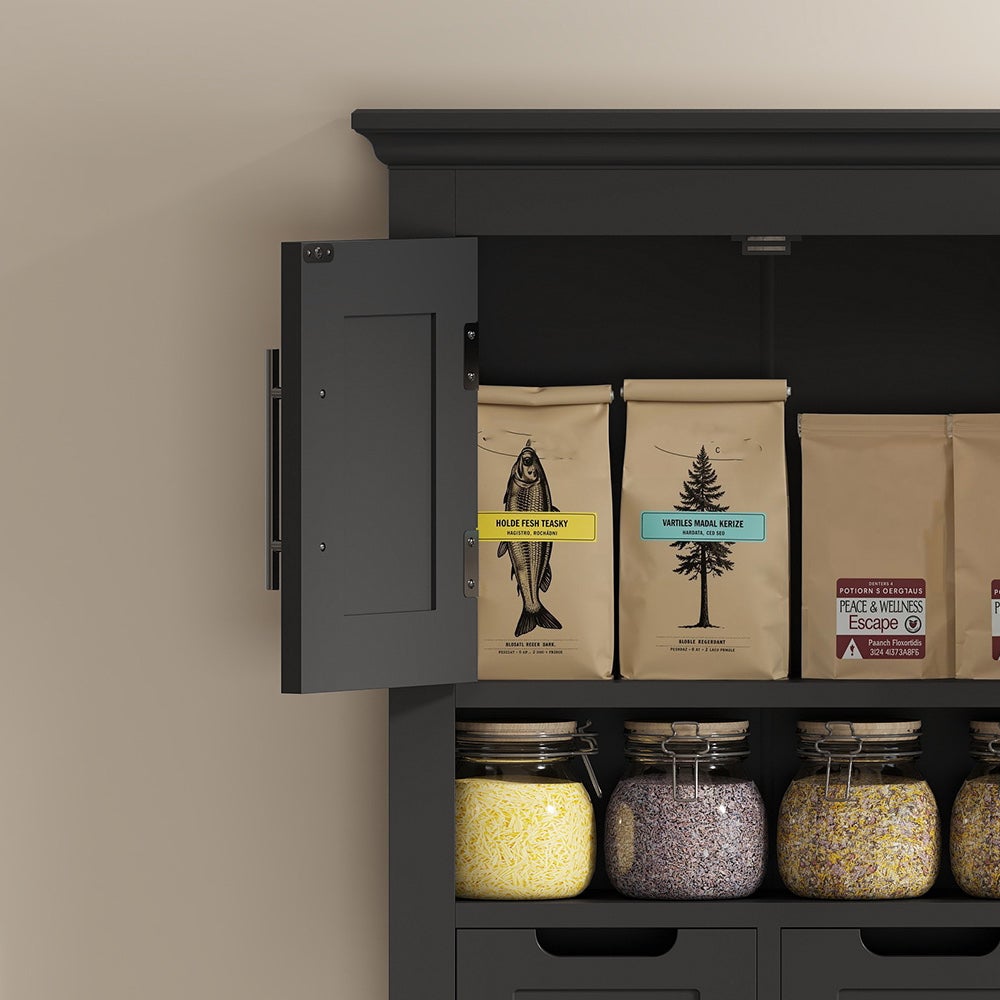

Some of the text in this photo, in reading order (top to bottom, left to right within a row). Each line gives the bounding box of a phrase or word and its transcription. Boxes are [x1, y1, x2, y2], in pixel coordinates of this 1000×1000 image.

[496, 519, 520, 527] HOLDE
[541, 520, 568, 528] TEASKY
[662, 519, 744, 528] VARTILES MADAL KERIZE
[840, 600, 923, 613] PEACE & WELLNESS
[849, 615, 898, 633] Escape
